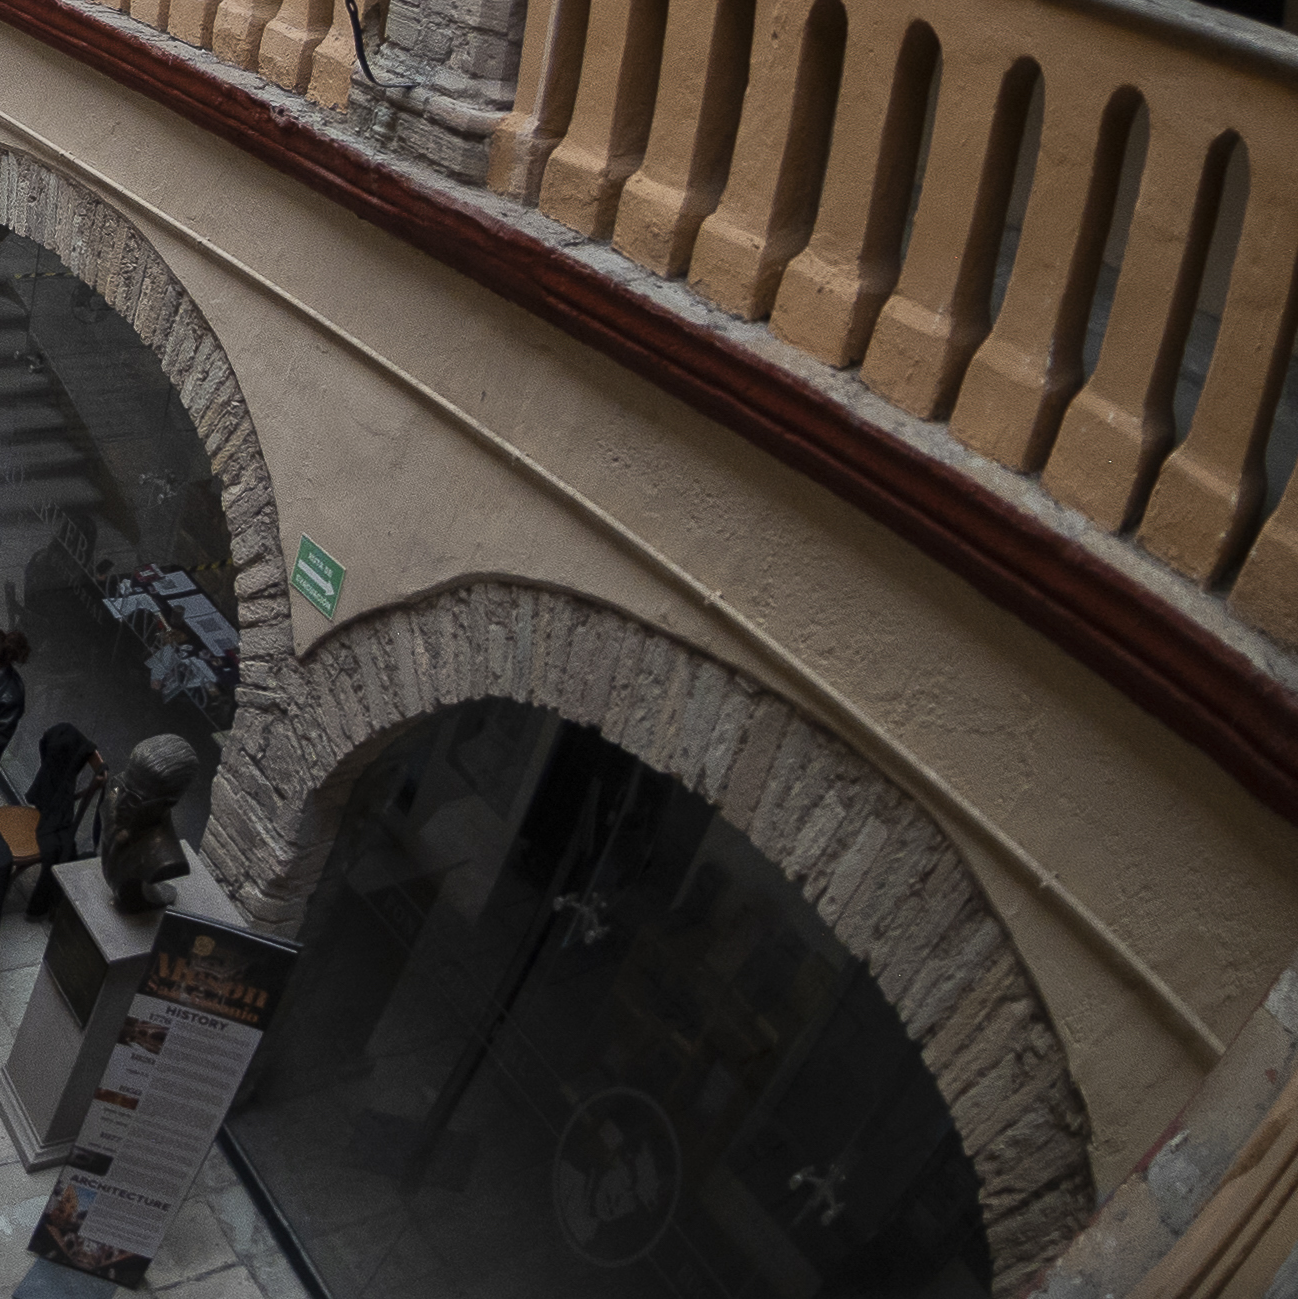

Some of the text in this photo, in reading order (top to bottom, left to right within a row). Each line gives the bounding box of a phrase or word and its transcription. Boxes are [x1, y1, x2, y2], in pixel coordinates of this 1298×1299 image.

[308, 552, 333, 578] RUTA DE
[166, 1006, 229, 1030] HISTORY
[70, 1174, 171, 1212] ARCHITECTURE
